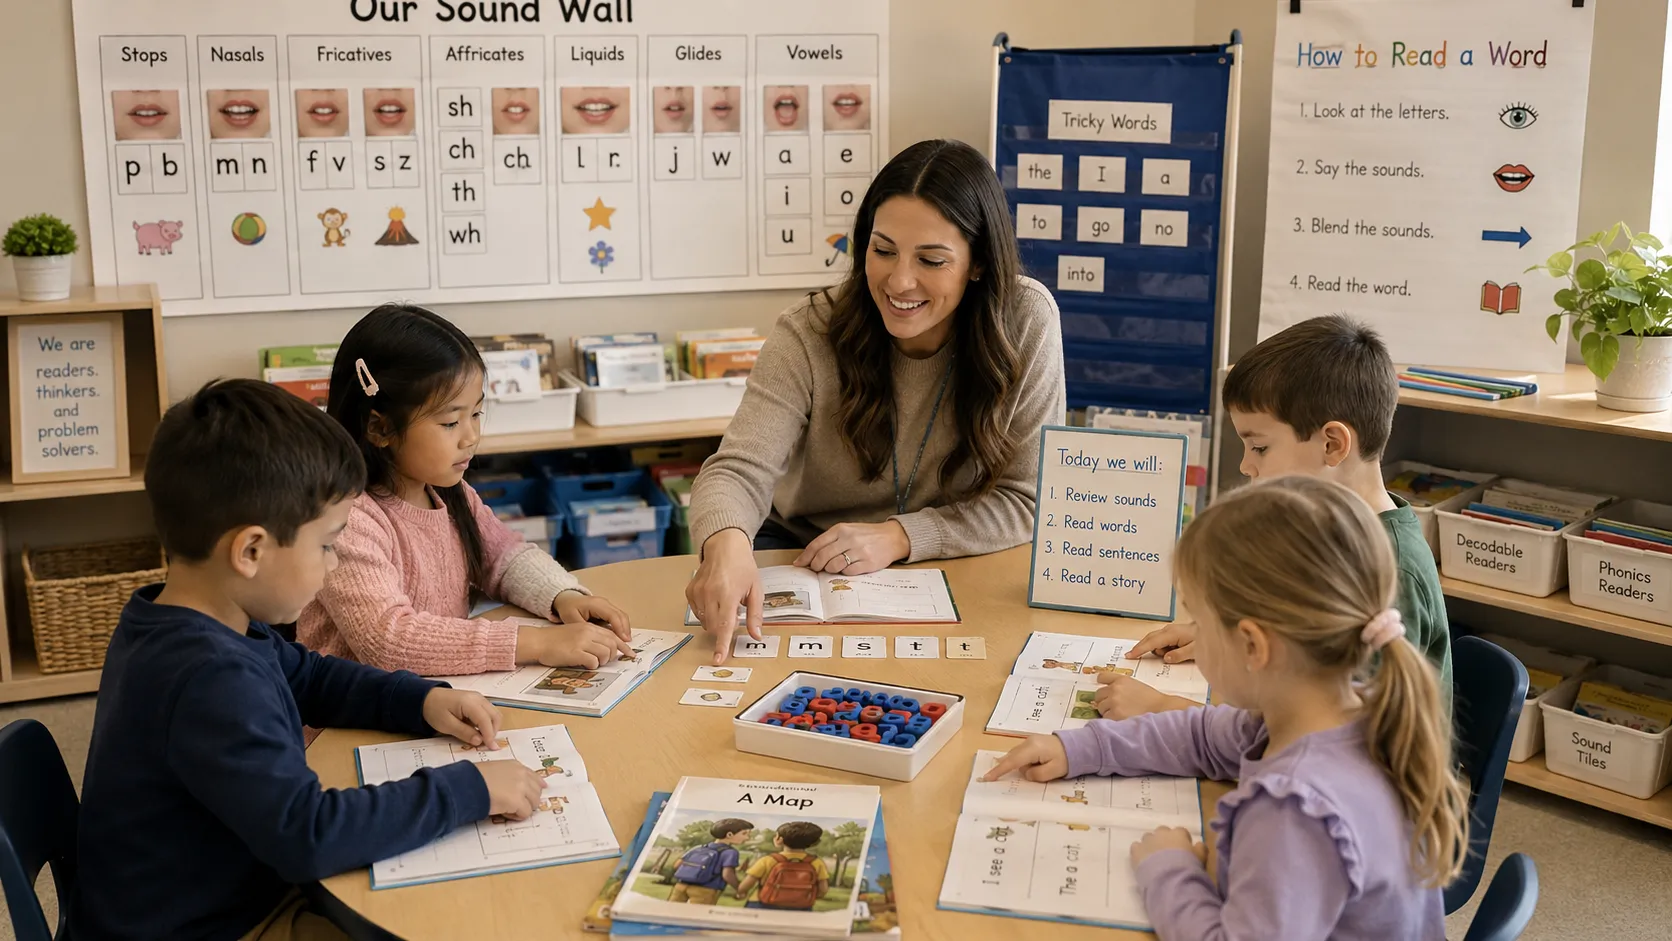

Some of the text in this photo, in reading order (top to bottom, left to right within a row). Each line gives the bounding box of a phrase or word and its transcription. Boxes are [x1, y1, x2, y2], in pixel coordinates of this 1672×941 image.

[350, 0, 632, 22] Our Sound Wall
[122, 47, 167, 67] Stops
[211, 46, 264, 61] Nasals
[318, 46, 391, 61] Fricatives
[446, 46, 524, 61] Affricates
[572, 46, 624, 65] Liquids
[676, 45, 721, 60] Glides
[787, 44, 842, 59] Vowels
[1297, 40, 1548, 68] How to Read a Word
[449, 95, 472, 116] sh
[1301, 102, 1448, 119] 1. Look at the letters.
[1062, 112, 1157, 134] Tricky Words
[449, 137, 474, 159] ch
[779, 150, 791, 163] a
[841, 149, 852, 163] e
[126, 153, 177, 184] p b
[217, 158, 266, 174] m n
[307, 150, 345, 172] f v
[375, 156, 411, 171] s z
[669, 147, 677, 174] j
[713, 152, 730, 166] w
[1028, 163, 1051, 179] the
[1098, 166, 1106, 182] I
[1296, 159, 1423, 179] 2. Say the sounds.
[1161, 174, 1170, 184] a
[452, 180, 475, 201] th
[785, 186, 789, 205] i
[841, 191, 853, 205] o
[1032, 215, 1046, 229] to
[1092, 221, 1109, 237] go
[1155, 225, 1173, 235] no
[1294, 217, 1433, 238] 3. Blend the sounds.
[449, 222, 480, 243] wh
[782, 230, 793, 243] u
[1068, 267, 1094, 282] into
[1290, 275, 1411, 296] 4. Read the word.
[38, 336, 95, 351] We are
[54, 403, 79, 418] and
[38, 422, 98, 442] problem
[1057, 448, 1162, 473] Today we will:
[1051, 487, 1156, 507] 1. Review sounds
[1047, 514, 1137, 533] 2. Read words
[1045, 541, 1159, 562] 3. Read sentences
[1457, 534, 1524, 558] Decodable
[1466, 551, 1516, 574] Readers
[1599, 560, 1651, 584] Phonics
[1043, 568, 1145, 594] 4. Read a story
[1599, 579, 1654, 602] Readers
[910, 642, 922, 650] t
[1572, 732, 1612, 755] Sound
[1577, 750, 1606, 770] Tiles
[737, 793, 813, 810] A Map
[990, 858, 1003, 876] see
[1059, 876, 1078, 896] The
